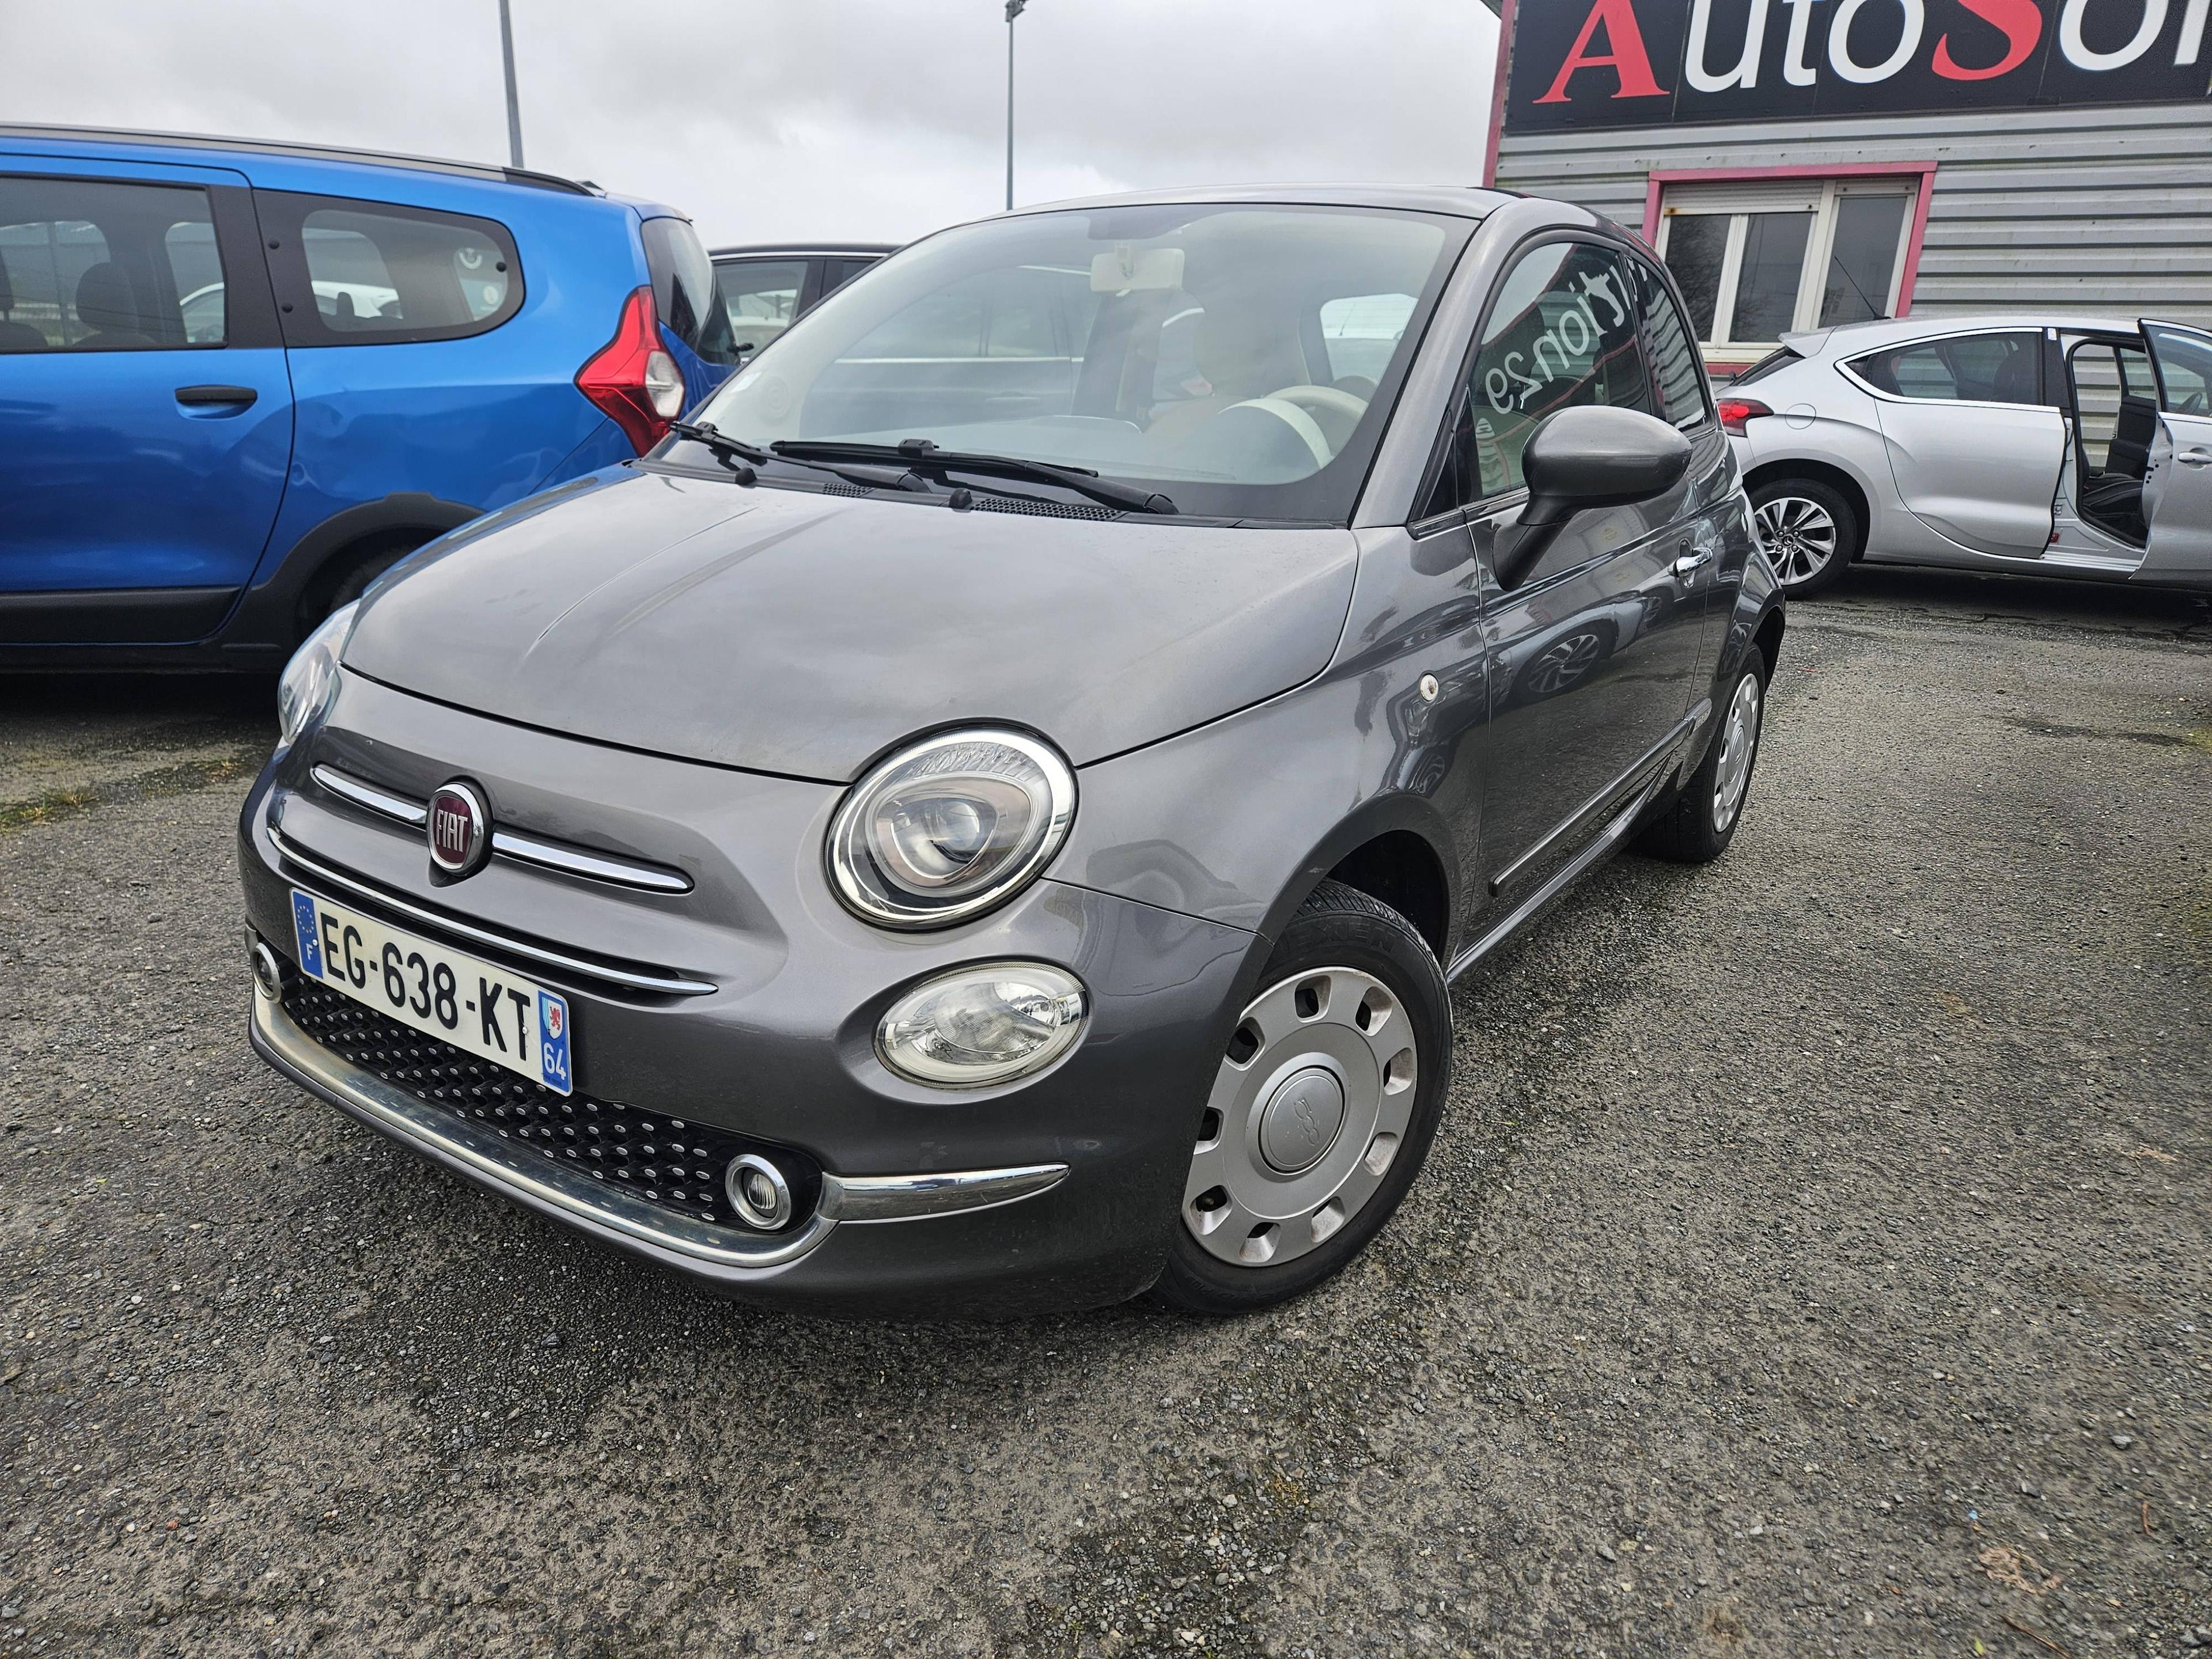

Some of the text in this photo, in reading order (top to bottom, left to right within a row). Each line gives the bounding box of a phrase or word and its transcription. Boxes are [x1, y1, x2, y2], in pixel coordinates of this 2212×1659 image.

[436, 809, 468, 853] FIAT
[306, 944, 313, 961] F
[320, 912, 531, 1062] EG-638-KT
[543, 1041, 567, 1082] 64
